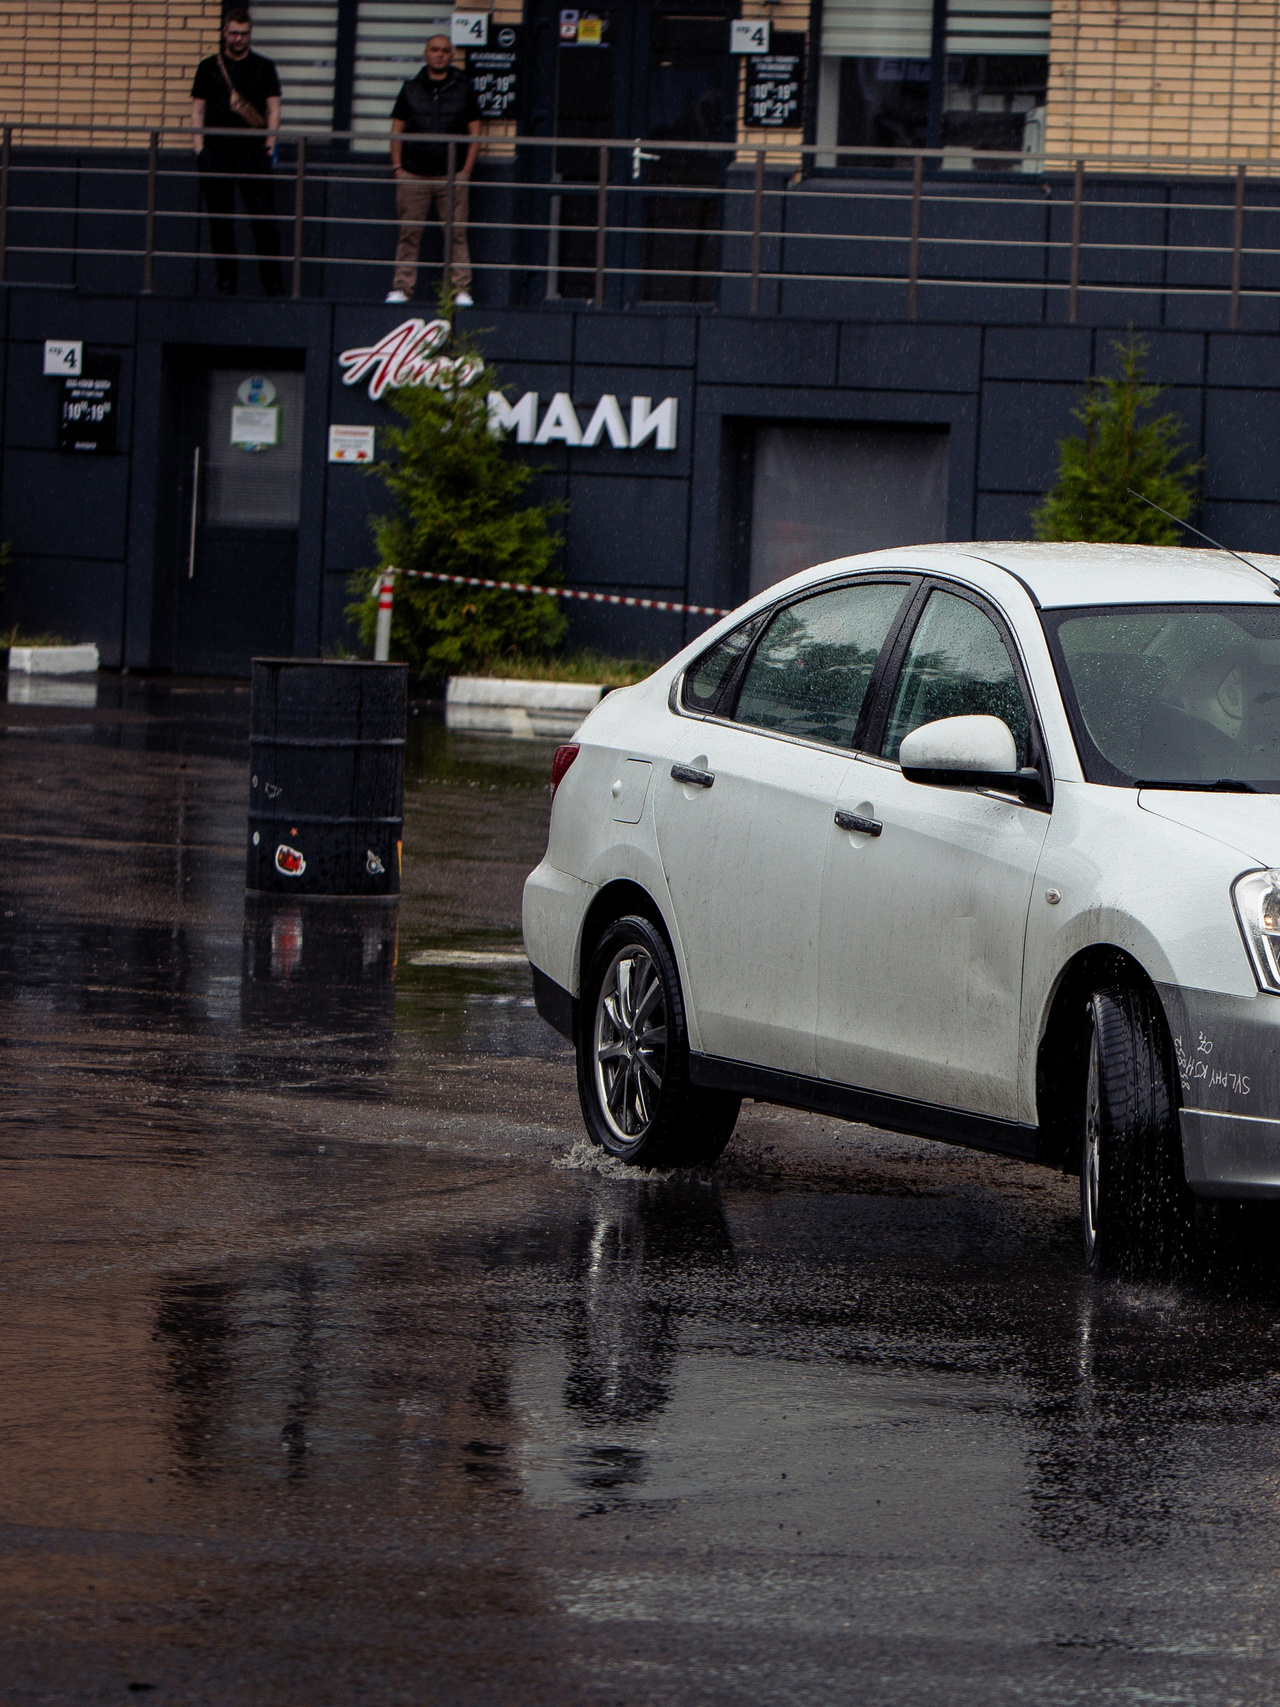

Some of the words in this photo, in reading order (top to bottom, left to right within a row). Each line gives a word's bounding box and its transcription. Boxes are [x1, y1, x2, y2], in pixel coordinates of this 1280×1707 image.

[470, 19, 484, 38] 4
[751, 26, 765, 46] 4
[63, 347, 78, 369] 4
[338, 318, 485, 401] Авто
[1208, 1068, 1251, 1095] SYLPHY
